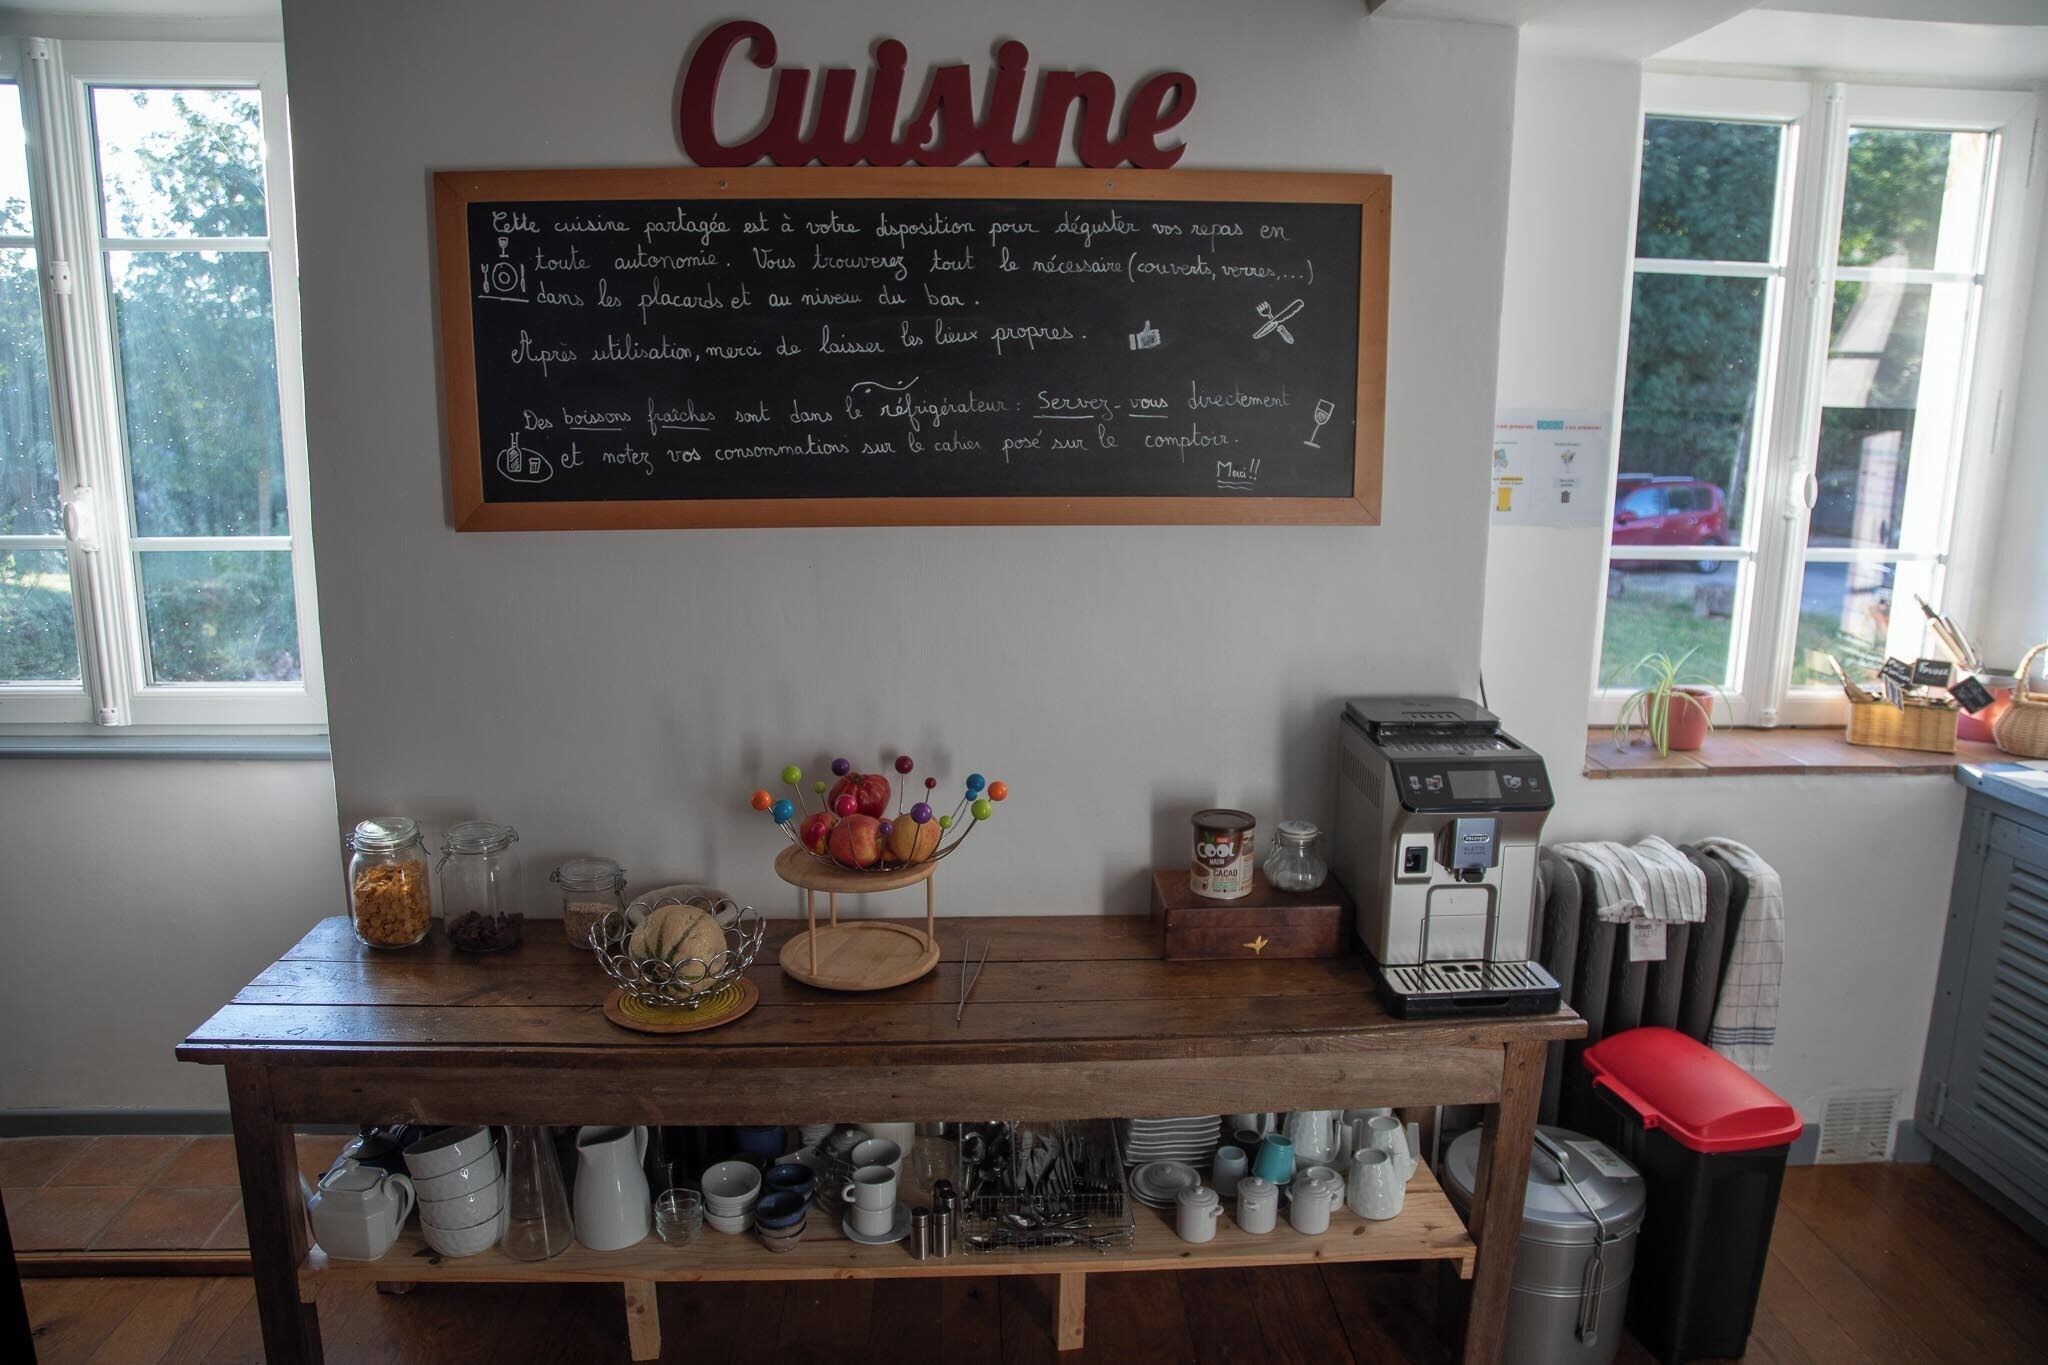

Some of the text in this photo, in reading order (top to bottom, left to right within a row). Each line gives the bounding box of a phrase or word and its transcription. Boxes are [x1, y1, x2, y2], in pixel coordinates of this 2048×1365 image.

[680, 20, 1197, 168] Cuisine
[493, 206, 1291, 252] Cette cuisine partagée est à votre disposition pour déguster vos repas en
[534, 245, 591, 271] toute
[753, 247, 796, 269] Vous
[812, 243, 908, 280] trouverez
[930, 245, 975, 272] tout
[1000, 246, 1020, 271] le
[1032, 254, 1123, 273] nécessaire
[537, 281, 585, 306] dans
[598, 278, 622, 307] les
[638, 276, 724, 325] placards
[731, 282, 751, 308] et
[769, 293, 792, 307] au
[801, 288, 862, 306] niveau
[878, 284, 906, 305] du
[511, 330, 577, 377] Après
[706, 341, 762, 359] merci
[776, 336, 801, 355] de
[820, 324, 885, 354] laisser
[901, 320, 923, 348] les
[935, 318, 978, 345] lieux
[523, 409, 554, 430] Des
[562, 407, 631, 427] boissons
[647, 397, 716, 436] fraîches
[735, 400, 770, 423] sont
[790, 399, 833, 423] dans
[845, 394, 863, 420] le
[1188, 379, 1291, 410] directement
[561, 442, 584, 468] et
[603, 442, 654, 476] notez
[667, 448, 701, 463] vos
[714, 434, 850, 461] consommations
[862, 440, 896, 454] sur
[908, 431, 926, 453] le
[934, 430, 981, 452] cahier
[1001, 430, 1043, 463] posé
[1051, 436, 1088, 450] sur
[1098, 423, 1119, 449] le
[1213, 869, 1238, 878] CACAO
